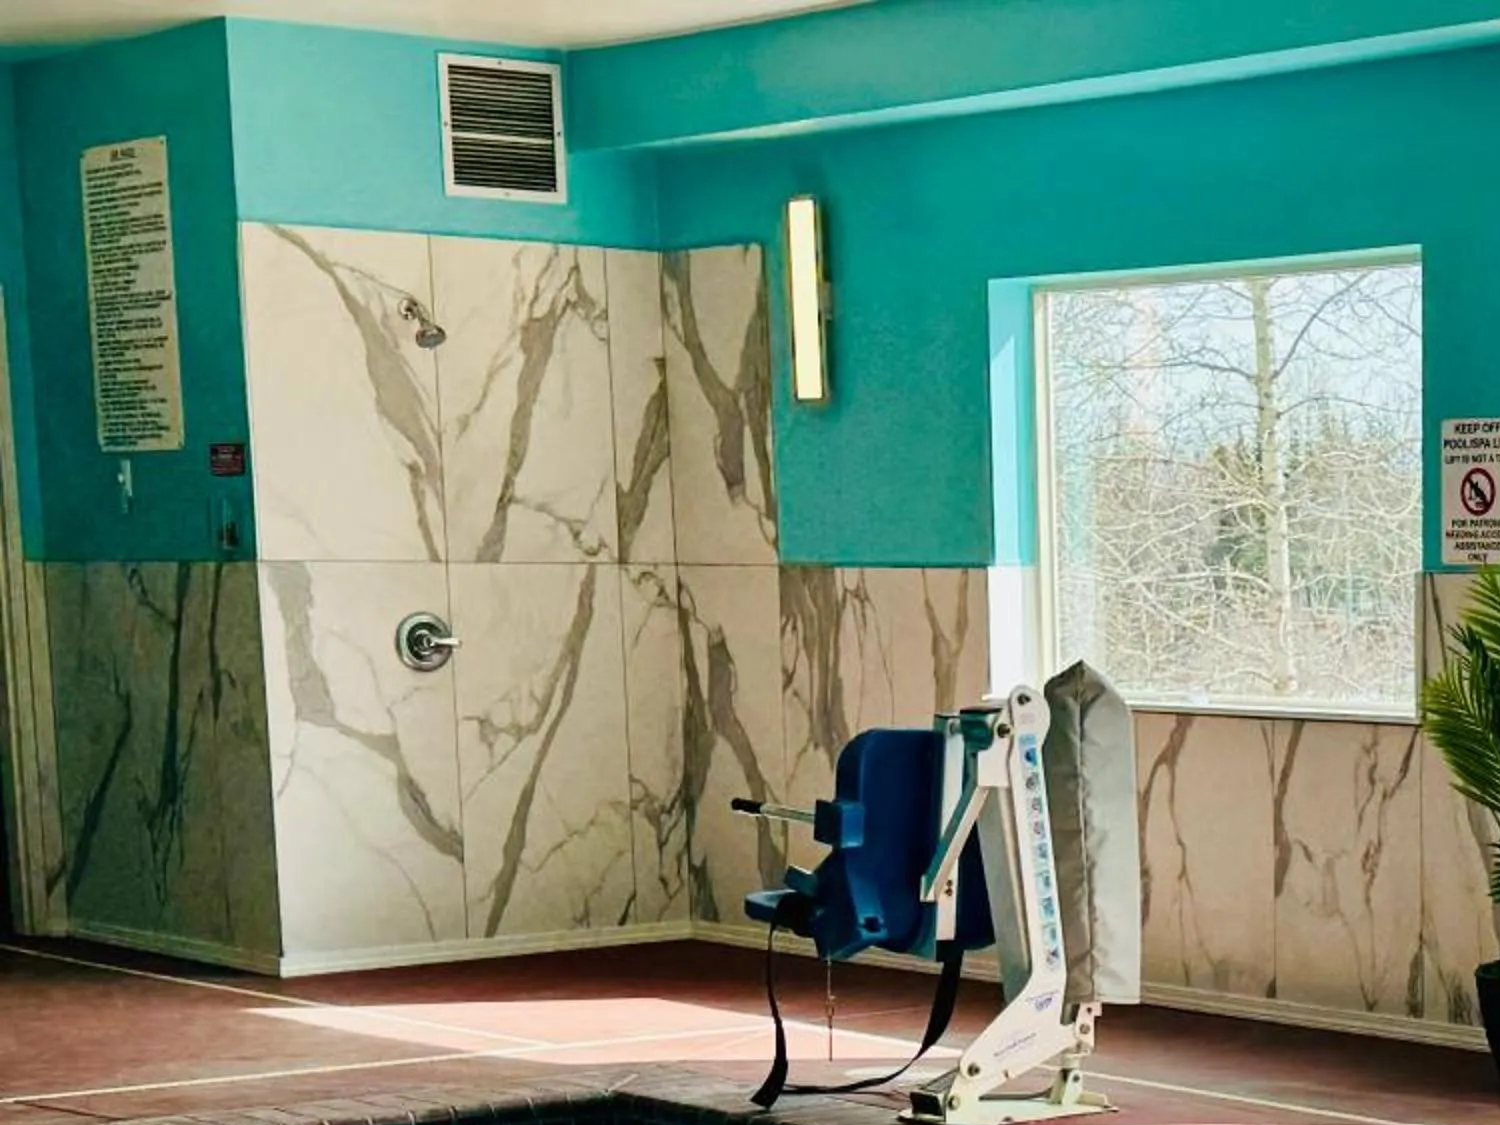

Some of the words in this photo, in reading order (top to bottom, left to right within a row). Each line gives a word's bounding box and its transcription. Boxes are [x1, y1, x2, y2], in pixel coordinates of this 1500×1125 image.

[1454, 423, 1480, 434] KEEP
[1482, 421, 1500, 432] OFF
[1471, 453, 1487, 463] NOT
[1467, 553, 1487, 562] ONLY
